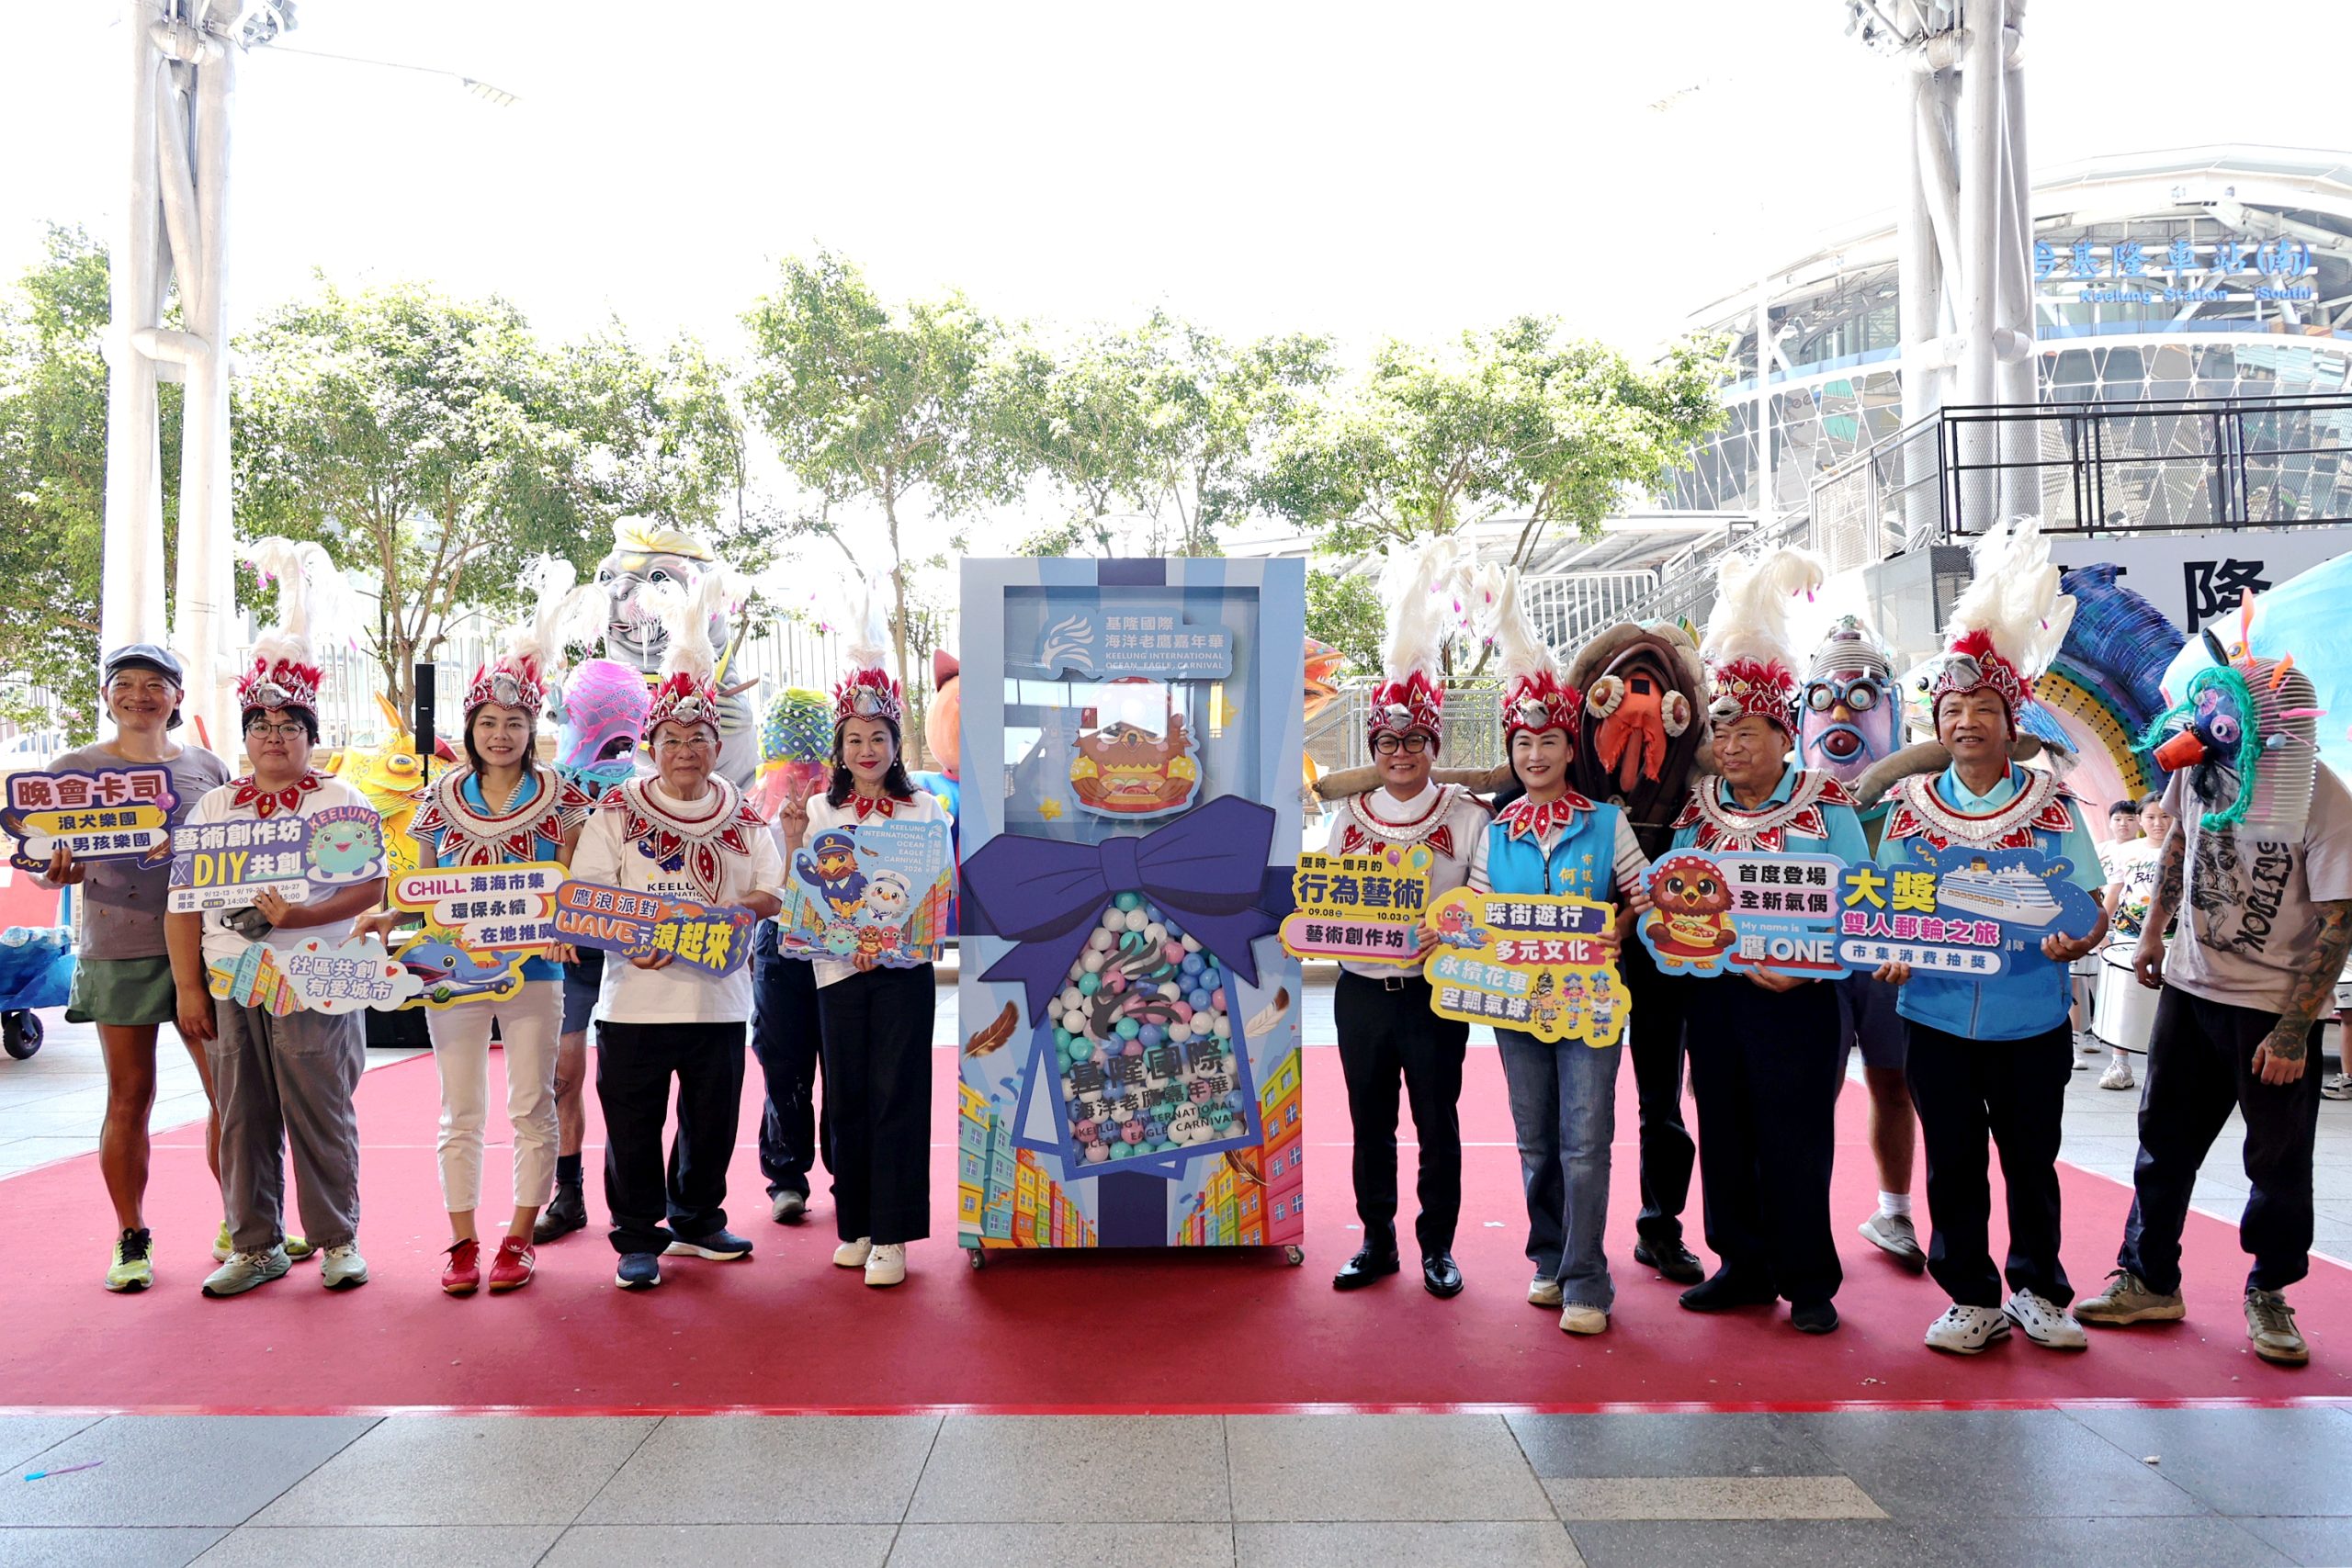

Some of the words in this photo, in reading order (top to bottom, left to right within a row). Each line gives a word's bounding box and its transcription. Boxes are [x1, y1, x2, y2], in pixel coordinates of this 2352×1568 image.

[2079, 289, 2152, 305] Keelung
[2162, 287, 2228, 301] Station
[2255, 287, 2312, 300] (South)
[1105, 616, 1173, 631] 基隆國際
[1105, 634, 1224, 649] 海洋老鷹嘉年華
[1177, 661, 1224, 670] CARNIVAL
[17, 775, 162, 807] 晚會卡司
[59, 811, 137, 830] 浪犬樂團
[309, 807, 379, 830] KEELUNG
[51, 832, 151, 852] 小男孩樂團
[174, 818, 302, 852] 藝術創作坊
[862, 830, 926, 840] INTERNATIONAL
[897, 840, 925, 849] OCEAN
[884, 856, 923, 864] CARNIVAL
[899, 849, 924, 857] EAGLE
[1301, 856, 1382, 872] 歷時一個月的
[407, 878, 467, 897] CHILL
[470, 873, 545, 893] 海海市集
[1738, 863, 1826, 886] 首度登場
[647, 882, 696, 892] KEELU
[1298, 873, 1424, 909] 行為藝術
[1843, 868, 1937, 913] 大獎
[451, 898, 526, 919] 環保永續
[571, 887, 660, 919] 鷹浪派對
[1739, 890, 1827, 912] 全新氣偶
[1308, 908, 1334, 917] 09.08
[1377, 912, 1401, 921] 10.03
[1484, 902, 1584, 928] 踩街遊行
[481, 923, 554, 943] 在地推廣
[556, 909, 639, 944] WAVE
[1306, 924, 1404, 947] 藝術創作坊
[1741, 921, 1757, 931] My
[1792, 923, 1800, 932] is
[1842, 910, 2000, 946] 雙人郵輪之旅
[1495, 939, 1590, 962] 多元文化
[1770, 938, 1836, 963] ONE
[289, 955, 378, 980] 社區共創
[1440, 954, 1530, 993] 永續花車
[306, 976, 393, 1000] 有愛城市
[1440, 987, 1529, 1019] 空飄氣球
[1070, 1038, 1224, 1096] 基隆國際
